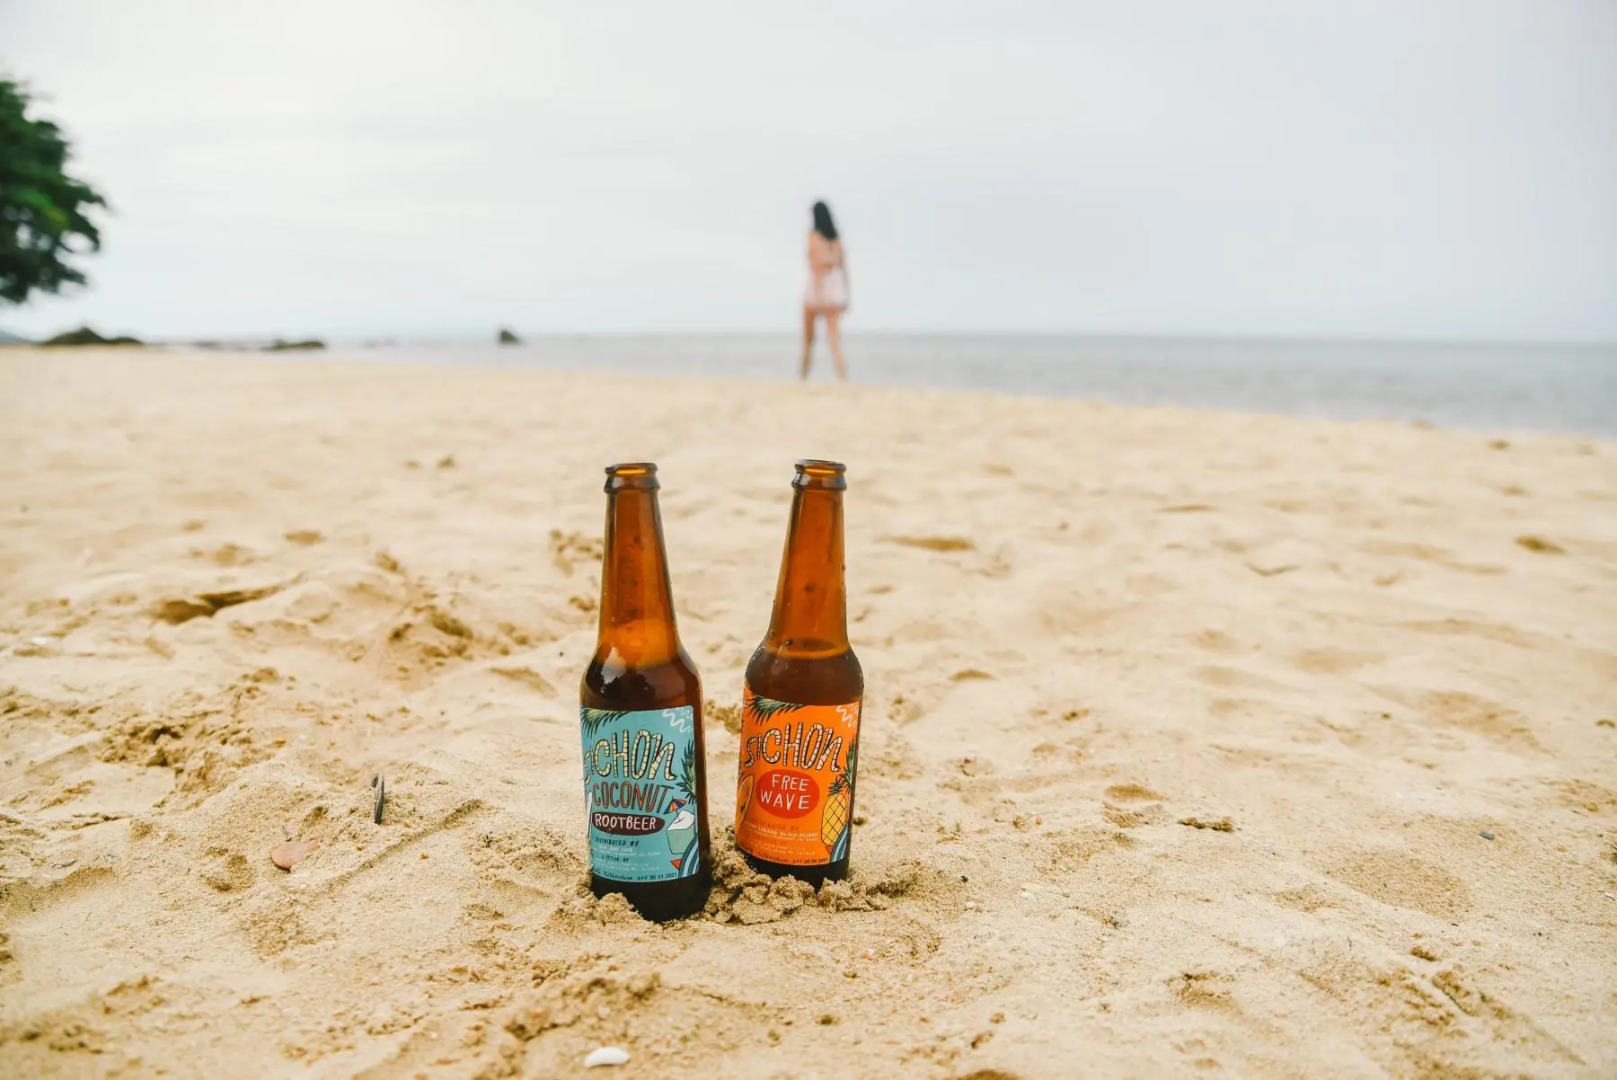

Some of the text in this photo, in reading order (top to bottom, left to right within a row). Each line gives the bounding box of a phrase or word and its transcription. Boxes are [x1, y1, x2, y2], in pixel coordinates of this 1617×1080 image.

[771, 773, 810, 792] FREE
[592, 781, 675, 814] COCONUT
[760, 789, 812, 811] WAVE
[594, 813, 656, 830] ROOTBEER
